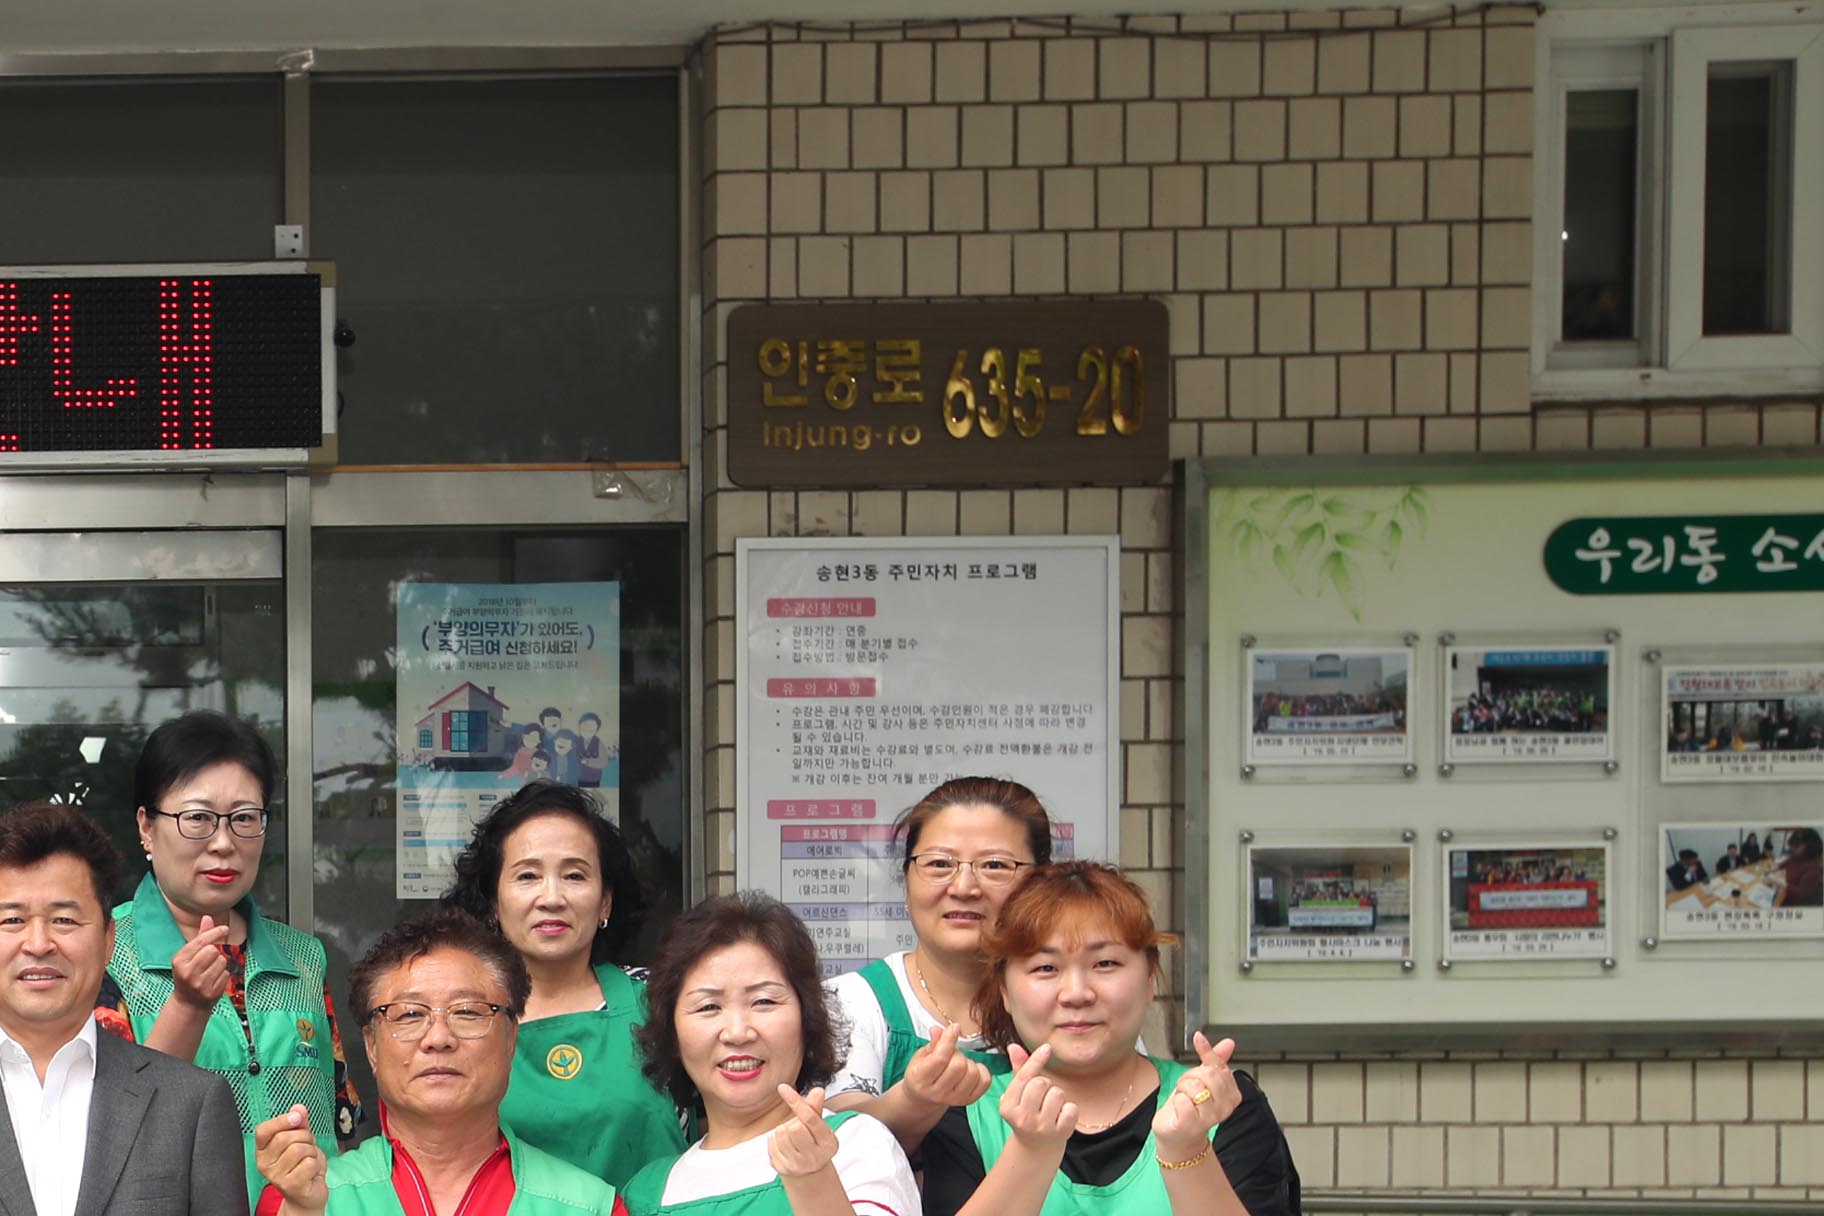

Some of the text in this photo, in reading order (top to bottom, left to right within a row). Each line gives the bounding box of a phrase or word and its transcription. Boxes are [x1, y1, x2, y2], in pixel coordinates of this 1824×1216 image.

[758, 338, 1144, 439] 인중로 635-20
[762, 421, 922, 451] Injung-ro
[1575, 525, 1726, 585] 우리동
[816, 563, 1038, 581] 송현3동 주민자치 프로그램
[505, 639, 577, 654] 신청하세요!
